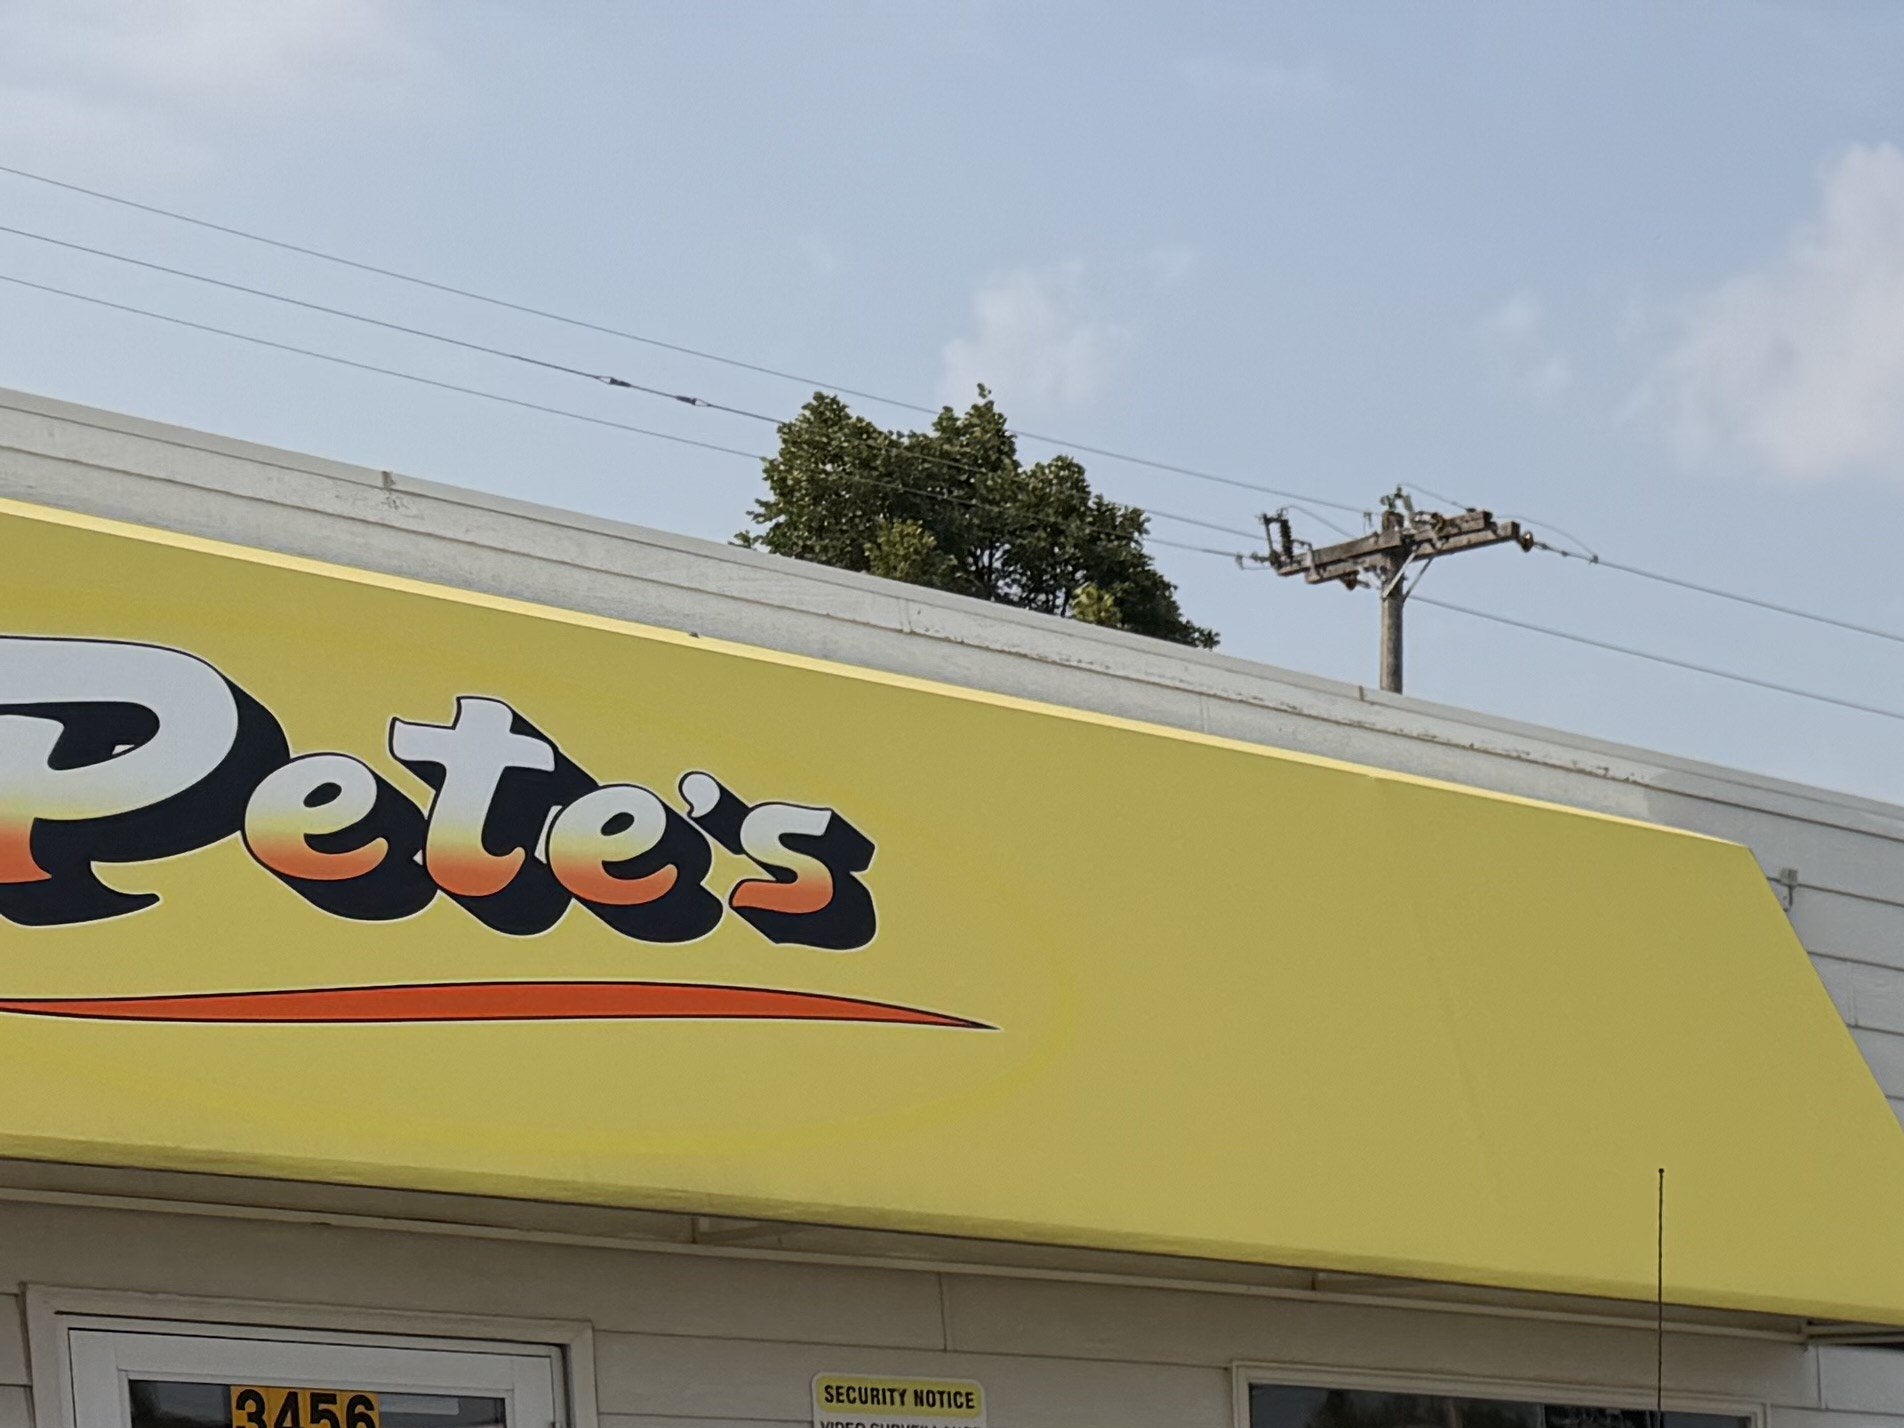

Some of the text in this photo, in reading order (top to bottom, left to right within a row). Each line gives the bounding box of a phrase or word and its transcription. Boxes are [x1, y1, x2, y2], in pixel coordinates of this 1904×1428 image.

[0, 635, 877, 950] Pete's
[824, 1384, 975, 1409] SECURITY NOTICE
